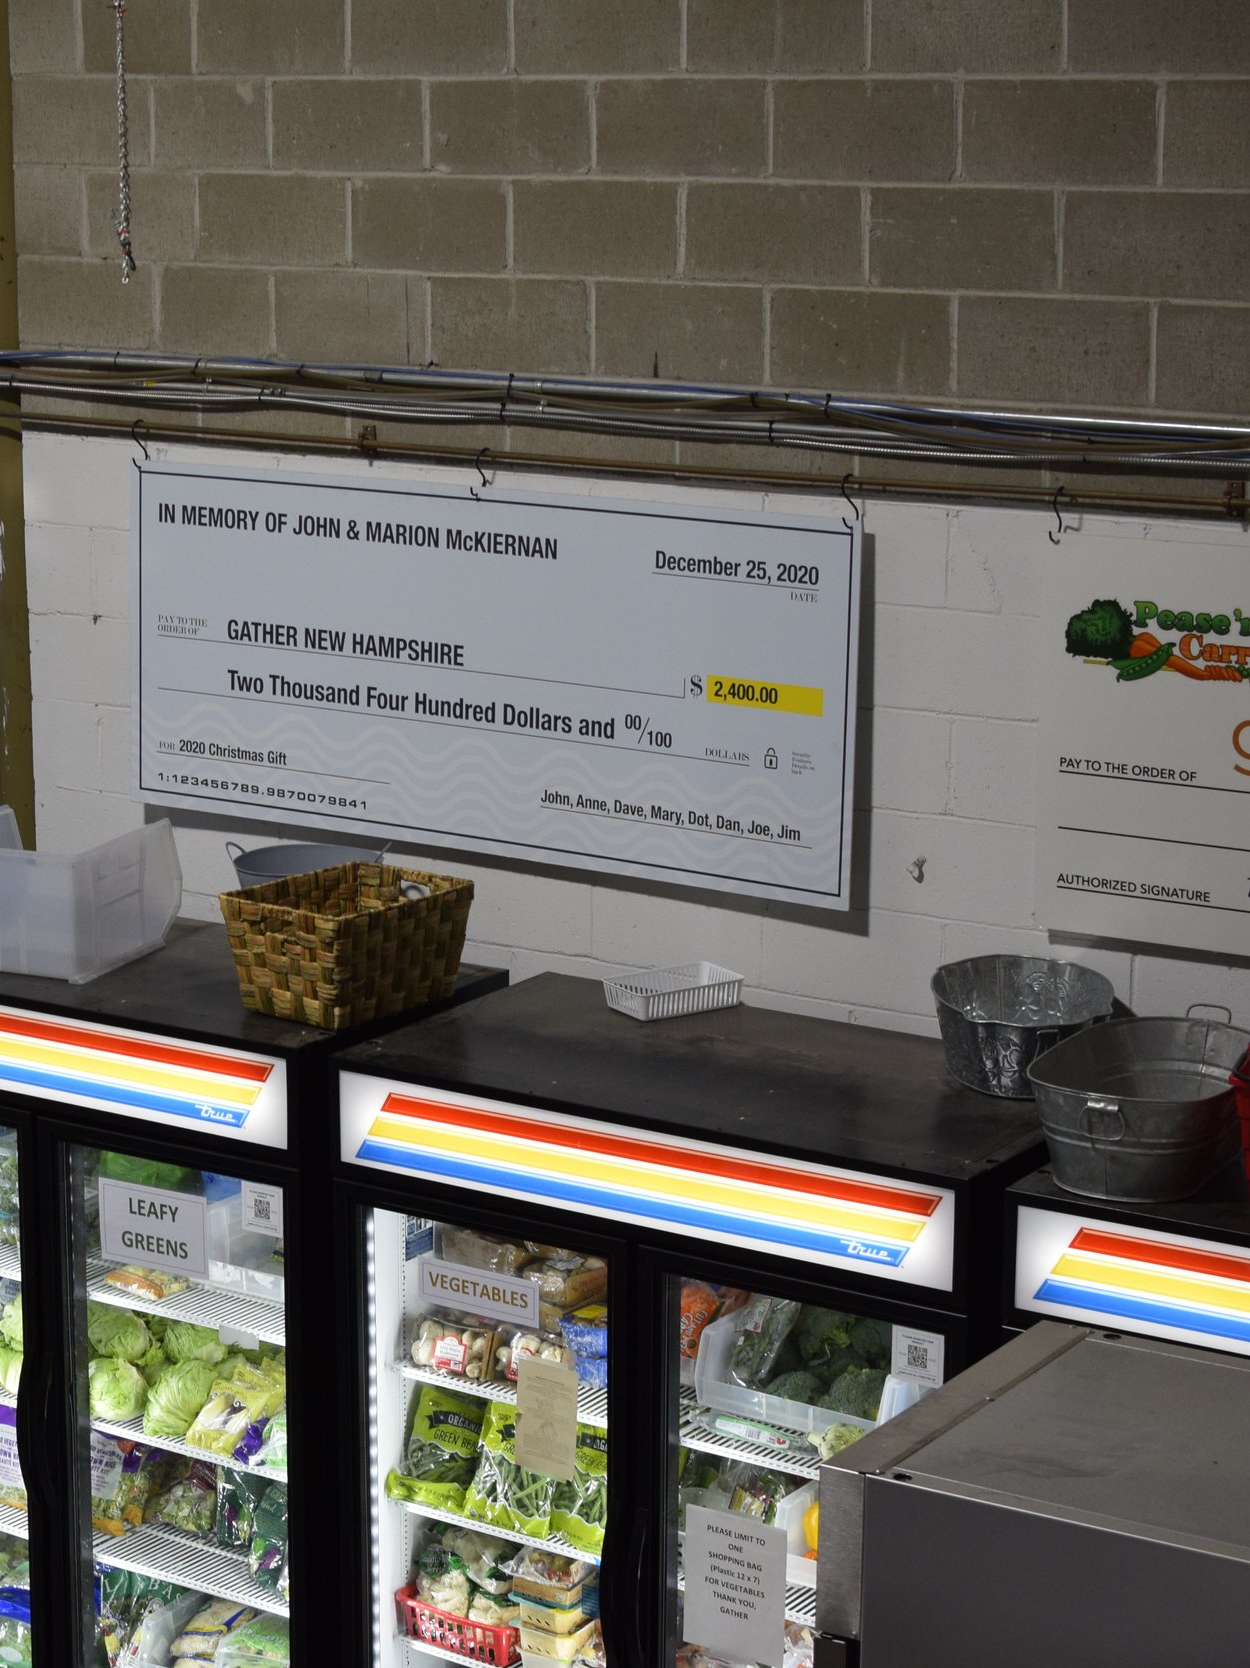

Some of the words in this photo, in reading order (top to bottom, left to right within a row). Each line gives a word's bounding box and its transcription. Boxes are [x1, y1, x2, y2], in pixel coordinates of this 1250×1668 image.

[158, 502, 176, 524] IN
[181, 504, 259, 531] MEMORY
[265, 512, 288, 533] OF
[292, 514, 341, 539] JOHN
[346, 519, 360, 541] &
[366, 521, 440, 549] MARION
[445, 528, 558, 560] McKIERNAN
[654, 550, 741, 578] December
[745, 559, 772, 585] 25,
[776, 563, 820, 586] 2020
[789, 590, 818, 604] DATE
[157, 614, 176, 626] PAY
[177, 616, 187, 626] TO
[187, 617, 208, 628] THE
[157, 623, 187, 635] ORDER
[188, 626, 200, 636] OF
[1133, 600, 1232, 636] Pease
[227, 618, 298, 648] GATHER
[304, 627, 346, 653] NEW
[352, 632, 465, 667] HAMPSHIRE
[689, 674, 703, 698] $
[713, 680, 779, 705] 2,400.00
[227, 669, 264, 693] Two
[269, 674, 360, 706] Thousand
[366, 686, 409, 712] Four
[414, 692, 496, 725] Hundred
[503, 703, 572, 734] Dollars
[578, 715, 615, 740] and
[158, 740, 176, 751] FOR
[179, 739, 206, 756] 2020
[208, 743, 265, 763] Christmas
[267, 750, 287, 766] Gift
[704, 747, 750, 762] DOLLARS
[1059, 756, 1082, 771] PAY
[1083, 758, 1102, 772] TO
[1104, 761, 1128, 775] THE
[1130, 764, 1176, 781] ORDER
[1178, 769, 1197, 783] OF
[157, 772, 368, 810] 1:123456789.9870079841
[540, 788, 574, 808] John,
[576, 794, 610, 814] Anne,
[613, 799, 647, 819] Dave,
[650, 805, 685, 826] Mary,
[688, 811, 713, 830] Dot,
[716, 815, 744, 835] Dan,
[747, 819, 774, 840] Joe,
[777, 823, 801, 842] Jim
[1057, 872, 1137, 894] AUTHORIZED
[1139, 882, 1211, 903] SIGNATURE
[128, 1196, 179, 1224] LEAFY
[121, 1230, 189, 1260] GREENS
[428, 1270, 529, 1309] VEGETABLES
[433, 1429, 460, 1446] GREEN
[707, 1524, 732, 1538] PLEASE
[734, 1532, 754, 1543] LIMIT
[755, 1537, 766, 1546] TO
[728, 1543, 743, 1554] ONE
[708, 1551, 745, 1567] SHOPPING
[746, 1561, 763, 1572] BAG
[710, 1563, 735, 1578] (Plastic
[737, 1572, 745, 1581] 12
[753, 1576, 760, 1585] 7)
[704, 1576, 719, 1585] FOR
[721, 1580, 765, 1599] VEGETABLES
[712, 1590, 737, 1604] THANK
[719, 1606, 749, 1620] GATHER
